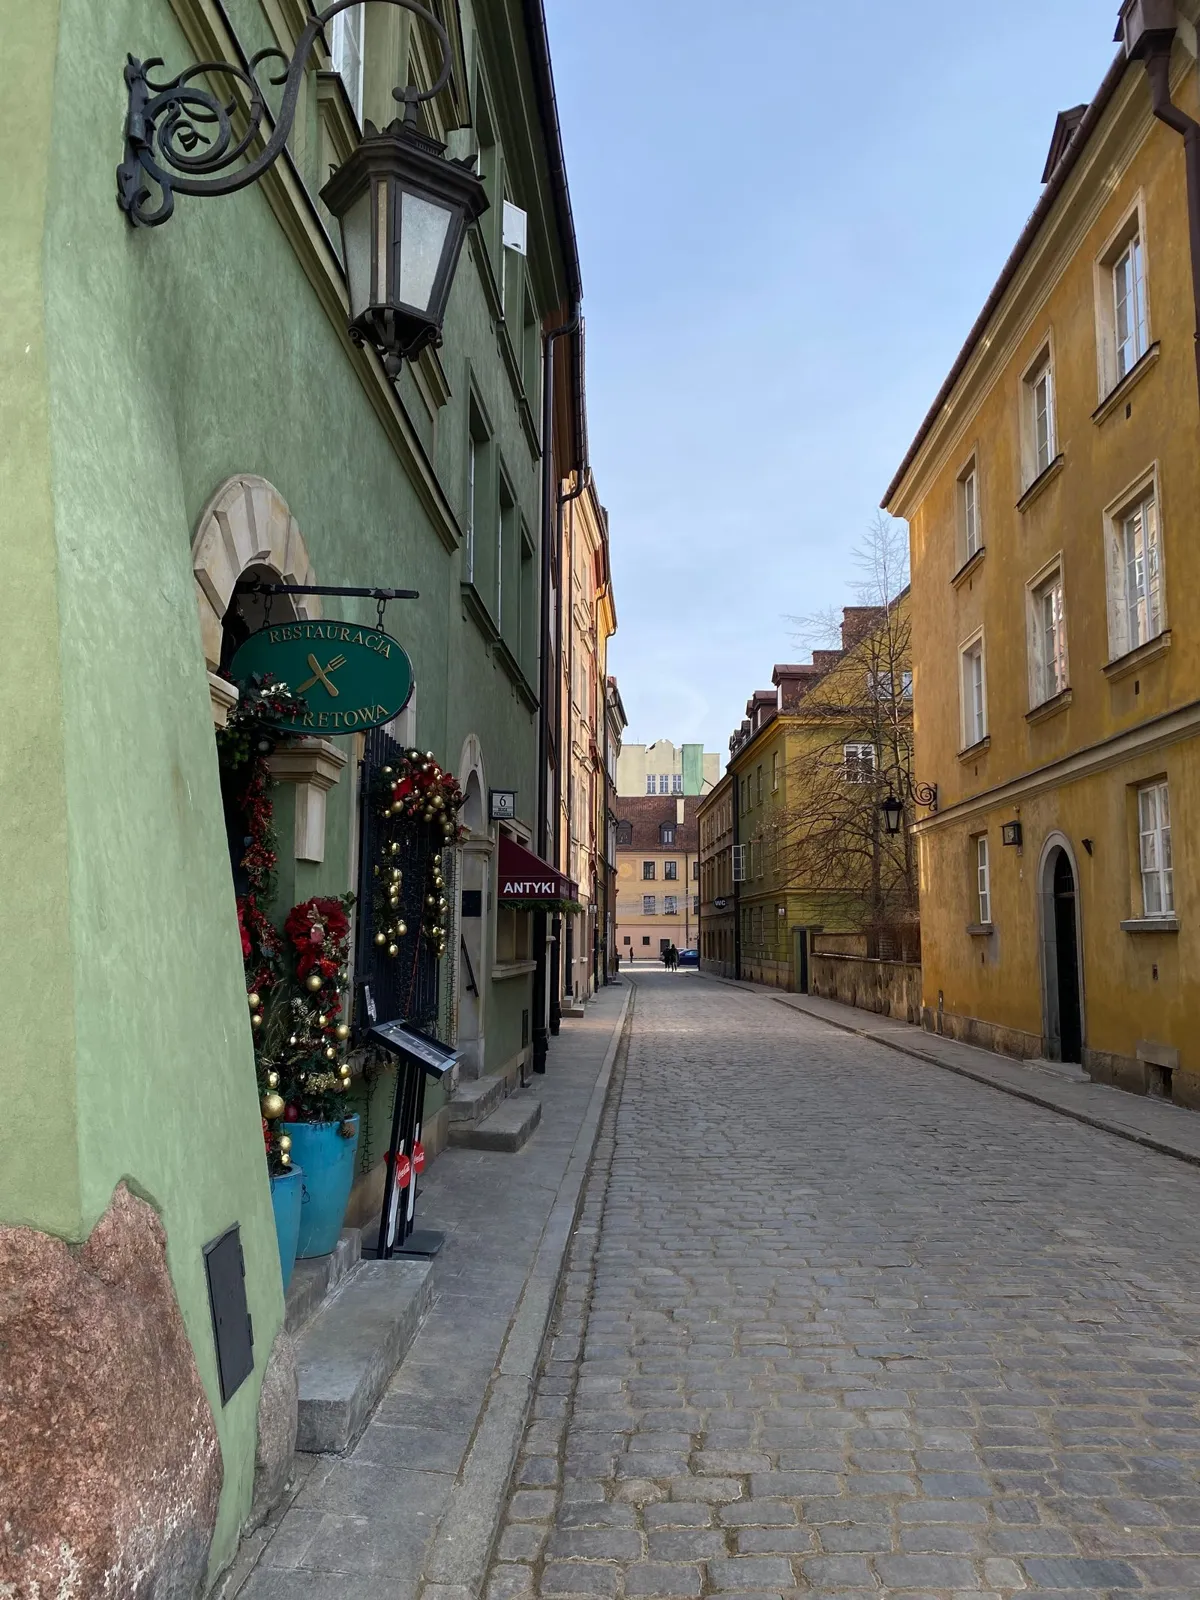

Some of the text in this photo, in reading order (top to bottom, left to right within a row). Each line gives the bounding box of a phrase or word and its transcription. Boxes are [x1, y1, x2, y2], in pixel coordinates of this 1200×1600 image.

[269, 625, 391, 658] RESTAURACJA
[499, 795, 506, 807] 6
[503, 882, 555, 893] ANTYKI
